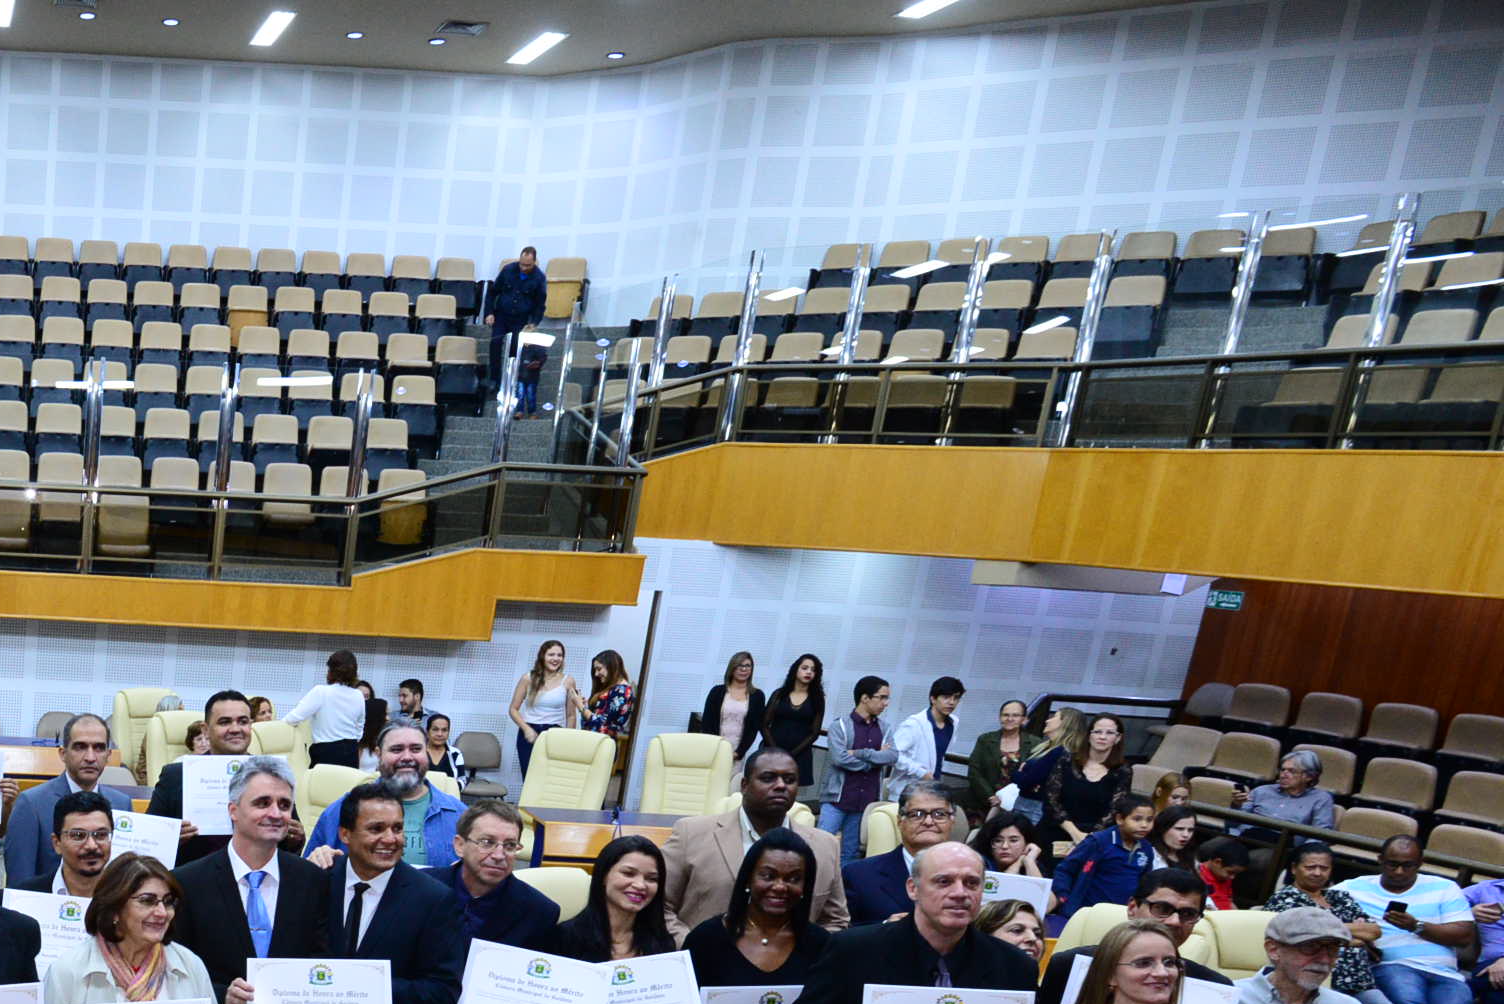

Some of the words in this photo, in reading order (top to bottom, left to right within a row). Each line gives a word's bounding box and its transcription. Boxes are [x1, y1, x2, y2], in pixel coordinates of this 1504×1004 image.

[488, 971, 516, 984] Diploma
[527, 980, 548, 990] Honra
[560, 988, 584, 997] Mérito
[272, 989, 301, 997] Diploma
[302, 989, 310, 997] de
[312, 989, 334, 998] Honra
[346, 990, 368, 998] Mérito
